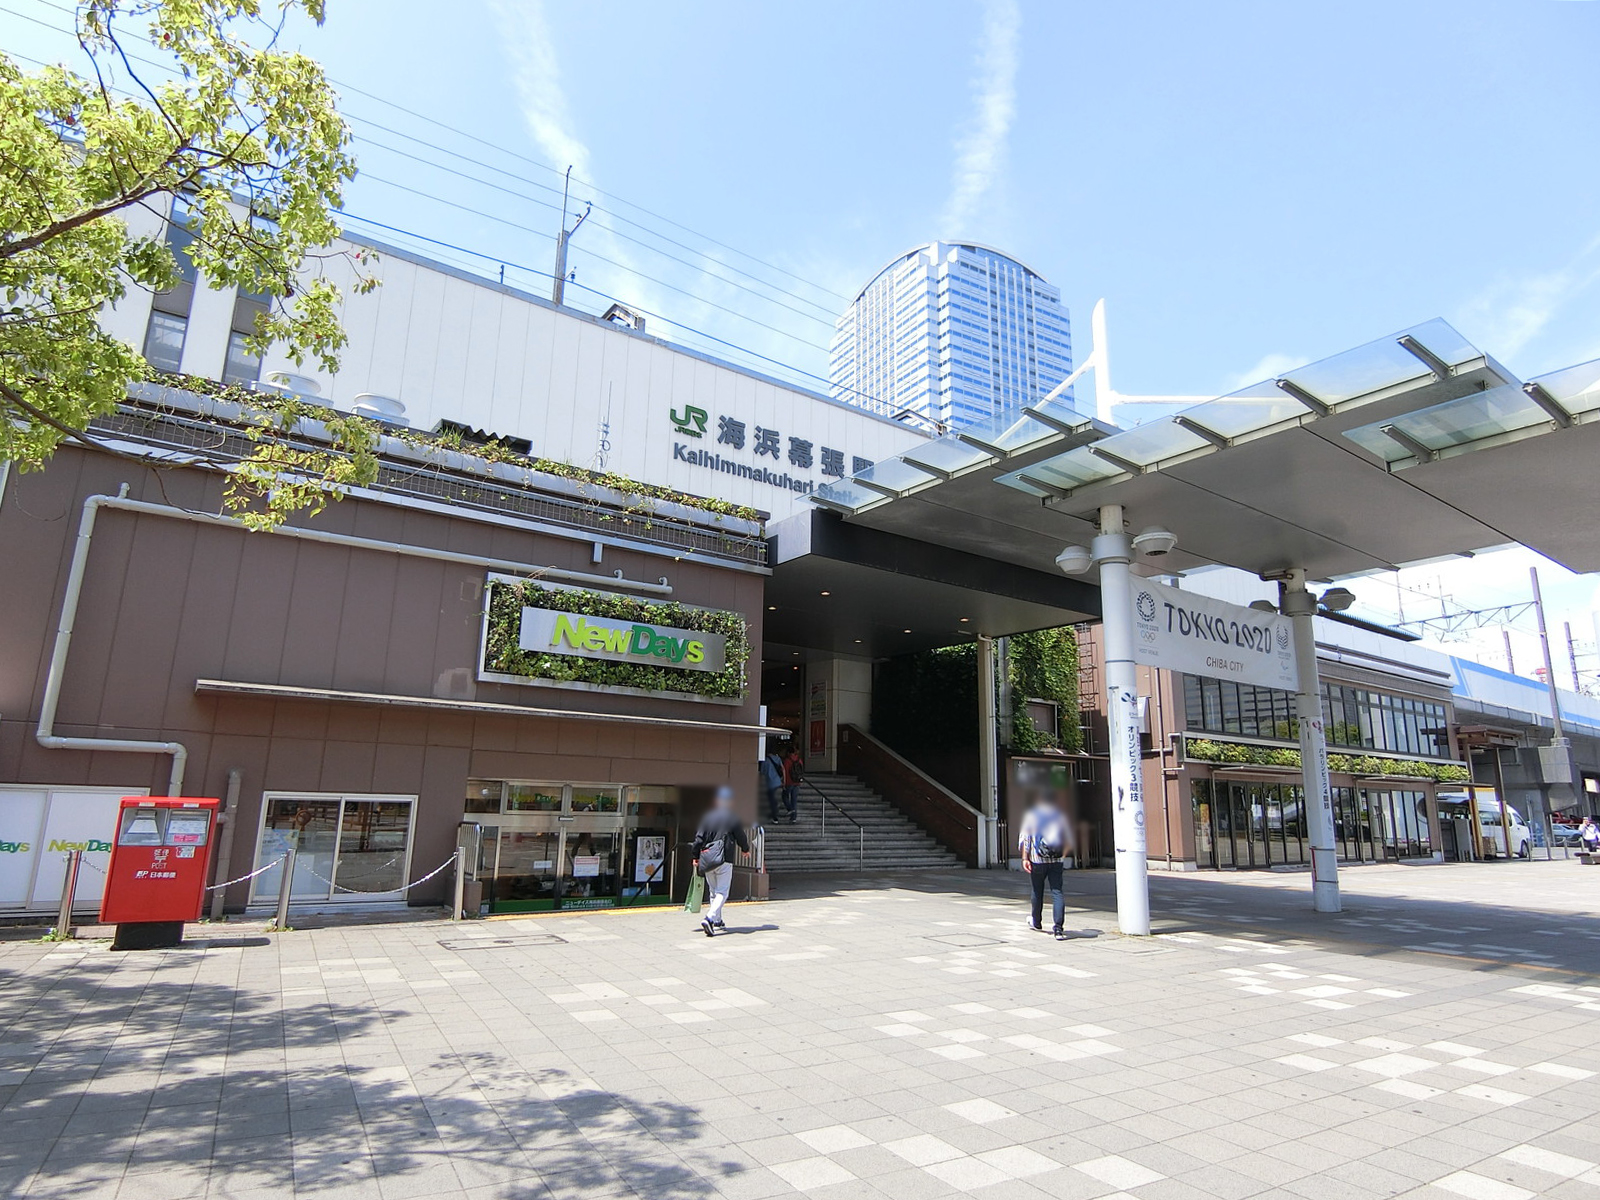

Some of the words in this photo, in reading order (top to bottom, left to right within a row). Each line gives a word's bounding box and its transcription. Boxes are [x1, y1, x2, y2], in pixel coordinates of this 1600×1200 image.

[670, 405, 708, 433] JR
[673, 442, 814, 494] Kaihimmakuhari
[552, 614, 705, 664] NewDays
[1164, 602, 1229, 644] TOKYO
[1230, 621, 1271, 654] 2020
[1206, 656, 1228, 670] CHIBA
[1229, 660, 1244, 673] CITY
